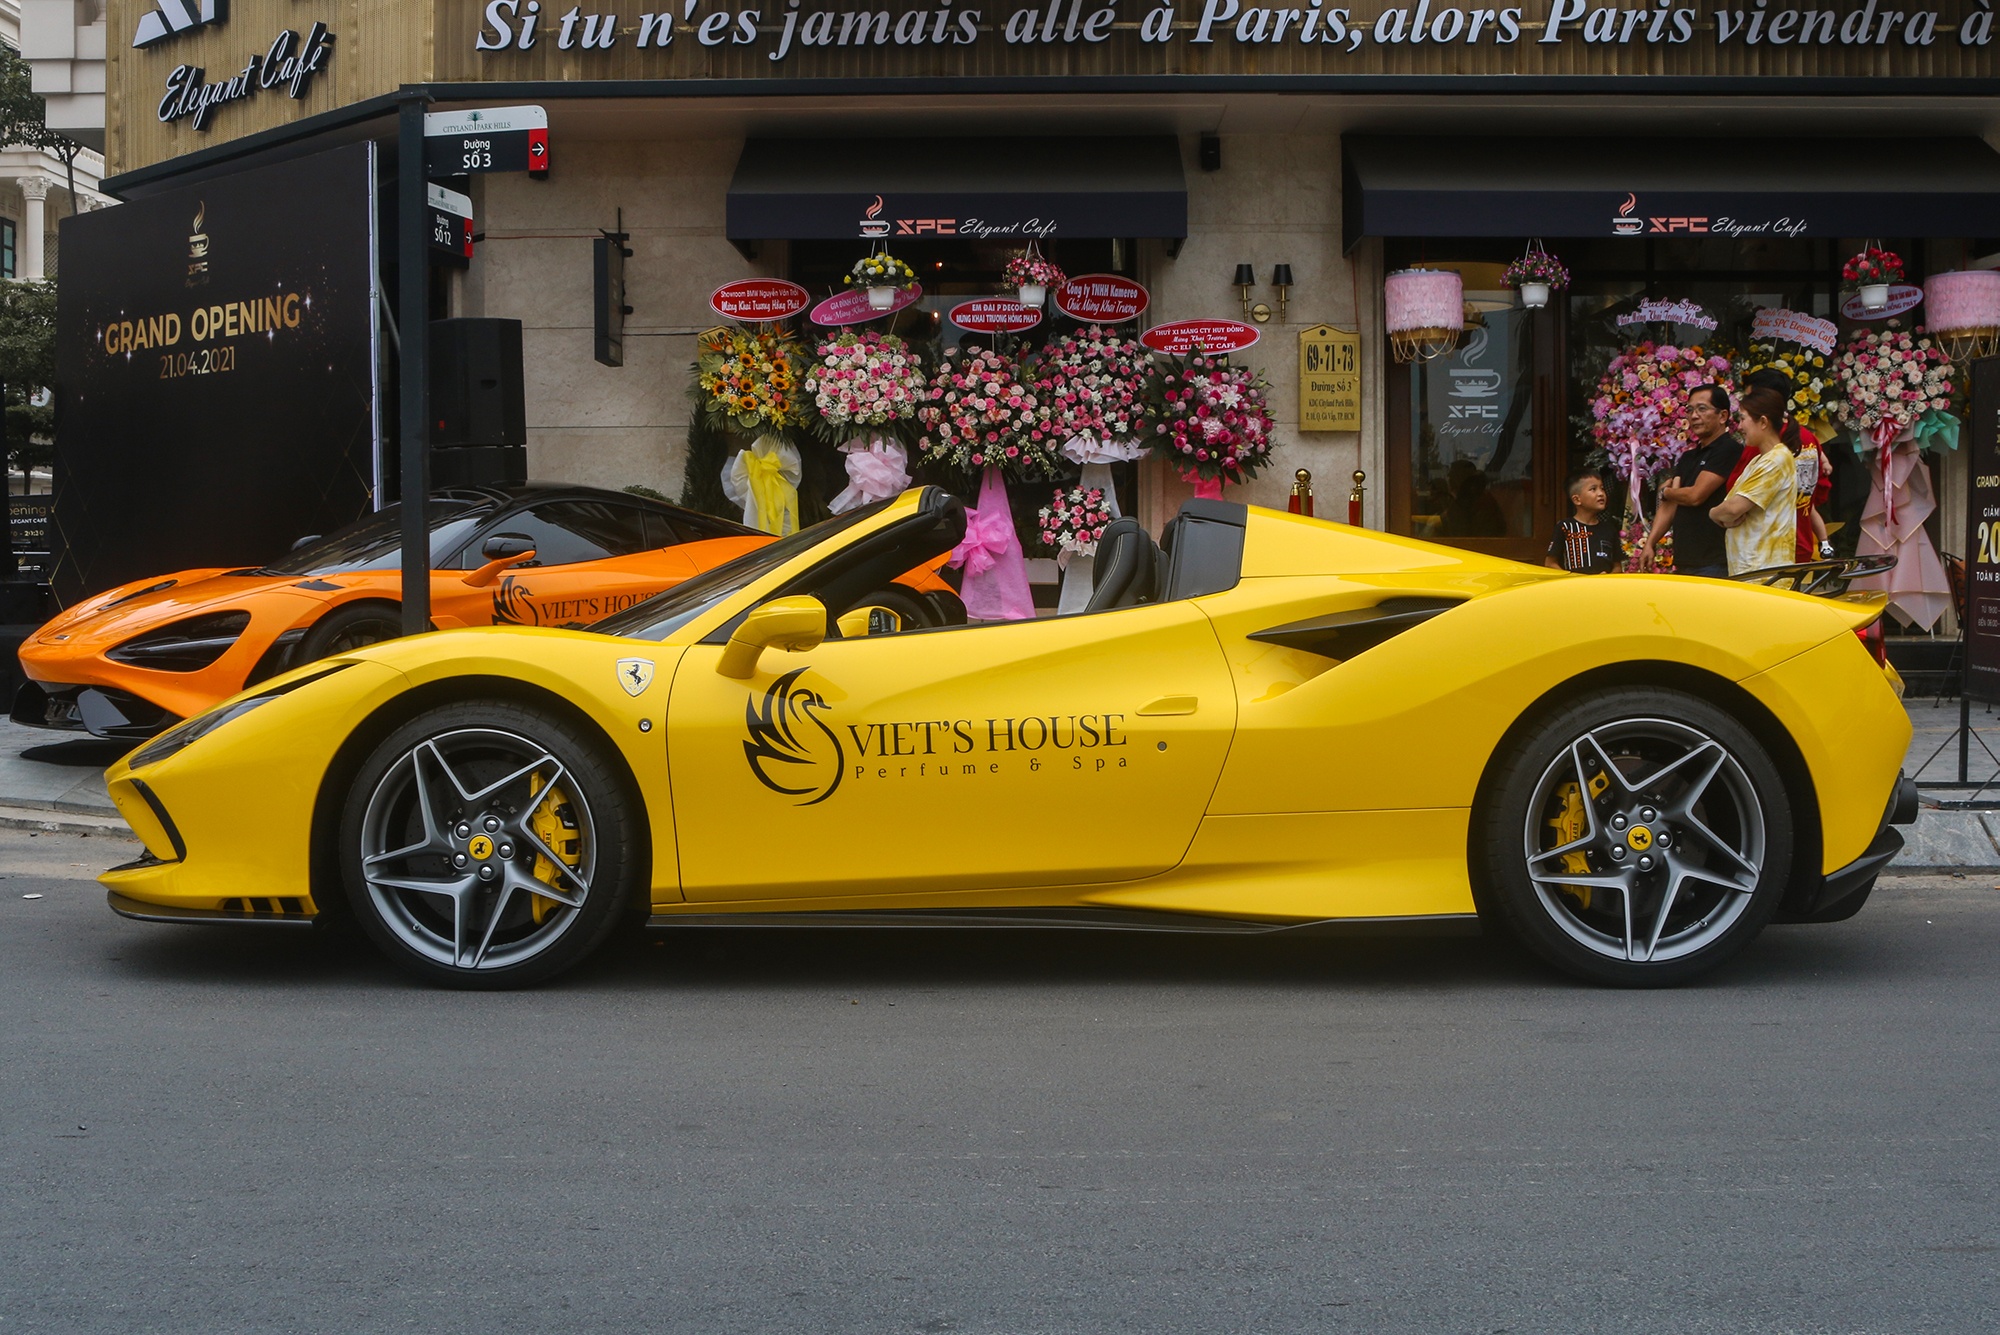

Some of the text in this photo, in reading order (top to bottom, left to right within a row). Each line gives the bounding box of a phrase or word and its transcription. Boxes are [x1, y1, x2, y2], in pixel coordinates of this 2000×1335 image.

[476, 0, 541, 50] Si
[557, 6, 616, 49] tu
[636, 0, 761, 48] n'es
[769, 0, 982, 61] jamais
[1005, 0, 1117, 43] allé
[1140, 1, 1175, 43] à
[1373, 0, 1521, 44] alors
[1537, 0, 1696, 44] Paris
[1714, 0, 1938, 45] viendra
[1959, 0, 1993, 45] à
[157, 54, 256, 131] Elegant
[260, 21, 327, 99] Café
[443, 121, 511, 133] CITYLAND PARK HILLS
[463, 139, 490, 151] Đường
[483, 152, 492, 168] 3
[959, 218, 1020, 238] Elegant
[1022, 217, 1057, 239] Café
[1711, 216, 1771, 238] Elegant
[1773, 216, 1807, 238] Café
[443, 231, 452, 246] 12
[720, 290, 746, 298] Showroom
[746, 289, 759, 297] BMW
[1083, 283, 1091, 299] ty
[1091, 283, 1110, 297] TNHH
[1110, 284, 1138, 299] Kamereo
[972, 303, 981, 312] EM
[105, 292, 300, 355] GRAND OPENING
[971, 314, 985, 323] KHAI
[1773, 318, 1790, 328] SPC
[1789, 320, 1818, 336] Elegant
[1216, 340, 1237, 349] CAFÉ
[159, 345, 235, 379] 21.04.2021
[1347, 381, 1352, 391] 3
[1440, 421, 1479, 438] Elegant
[1976, 475, 2000, 488] GRAND
[604, 592, 661, 614] HOU
[847, 713, 1127, 758] VIET'S HOUSE
[855, 755, 1127, 779] Perfume & Spa
